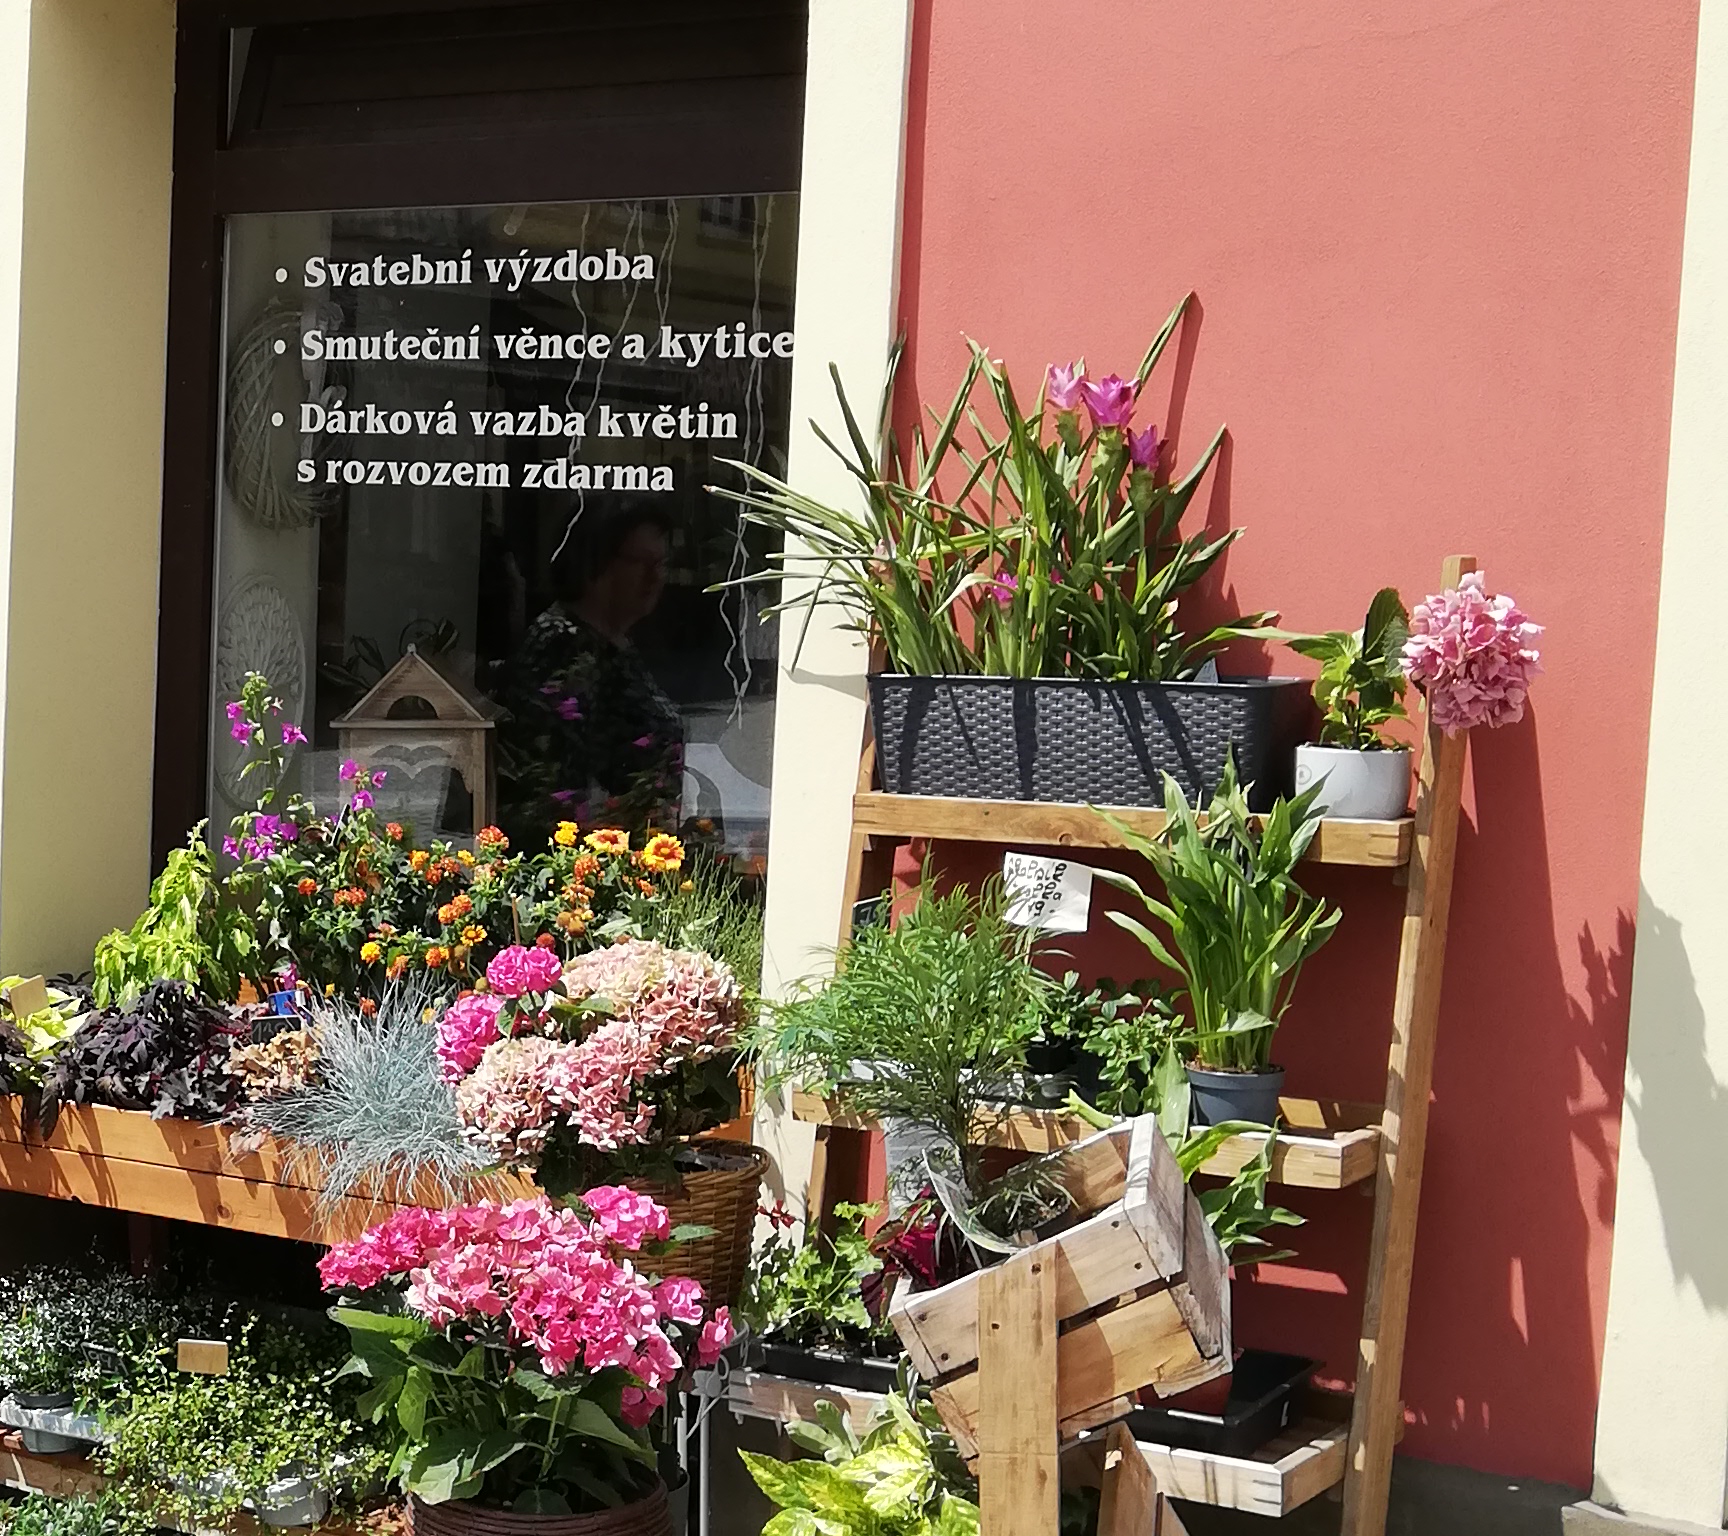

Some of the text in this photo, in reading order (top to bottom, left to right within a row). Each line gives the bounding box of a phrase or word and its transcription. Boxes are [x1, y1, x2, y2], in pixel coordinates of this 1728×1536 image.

[304, 248, 655, 292] Svatební výzdoba
[301, 322, 795, 368] Smuteční věnce a kytice
[299, 400, 738, 439] Dárková vazba květin
[297, 457, 675, 491] s rozvozem zdarma
